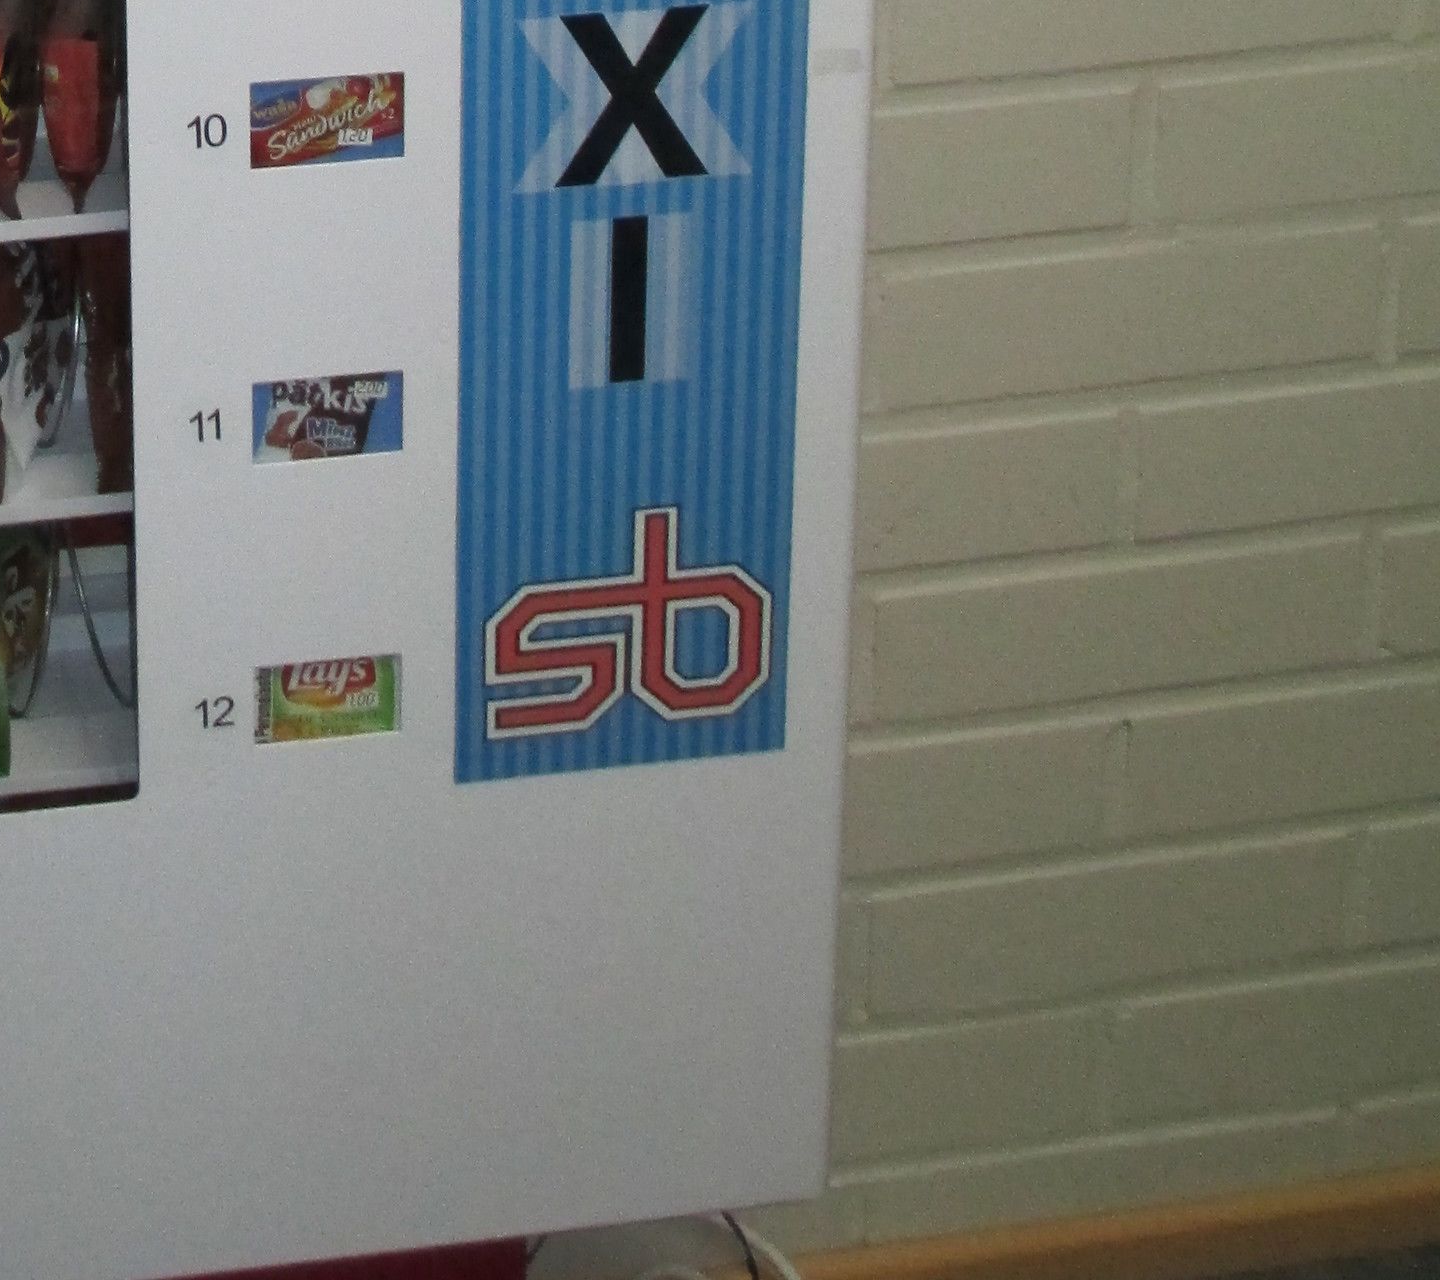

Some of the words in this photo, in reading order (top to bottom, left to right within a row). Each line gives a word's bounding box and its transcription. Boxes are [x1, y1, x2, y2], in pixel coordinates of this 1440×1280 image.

[187, 112, 228, 150] 10
[266, 86, 391, 161] Sandwich
[189, 408, 222, 443] 11
[194, 695, 236, 730] 12
